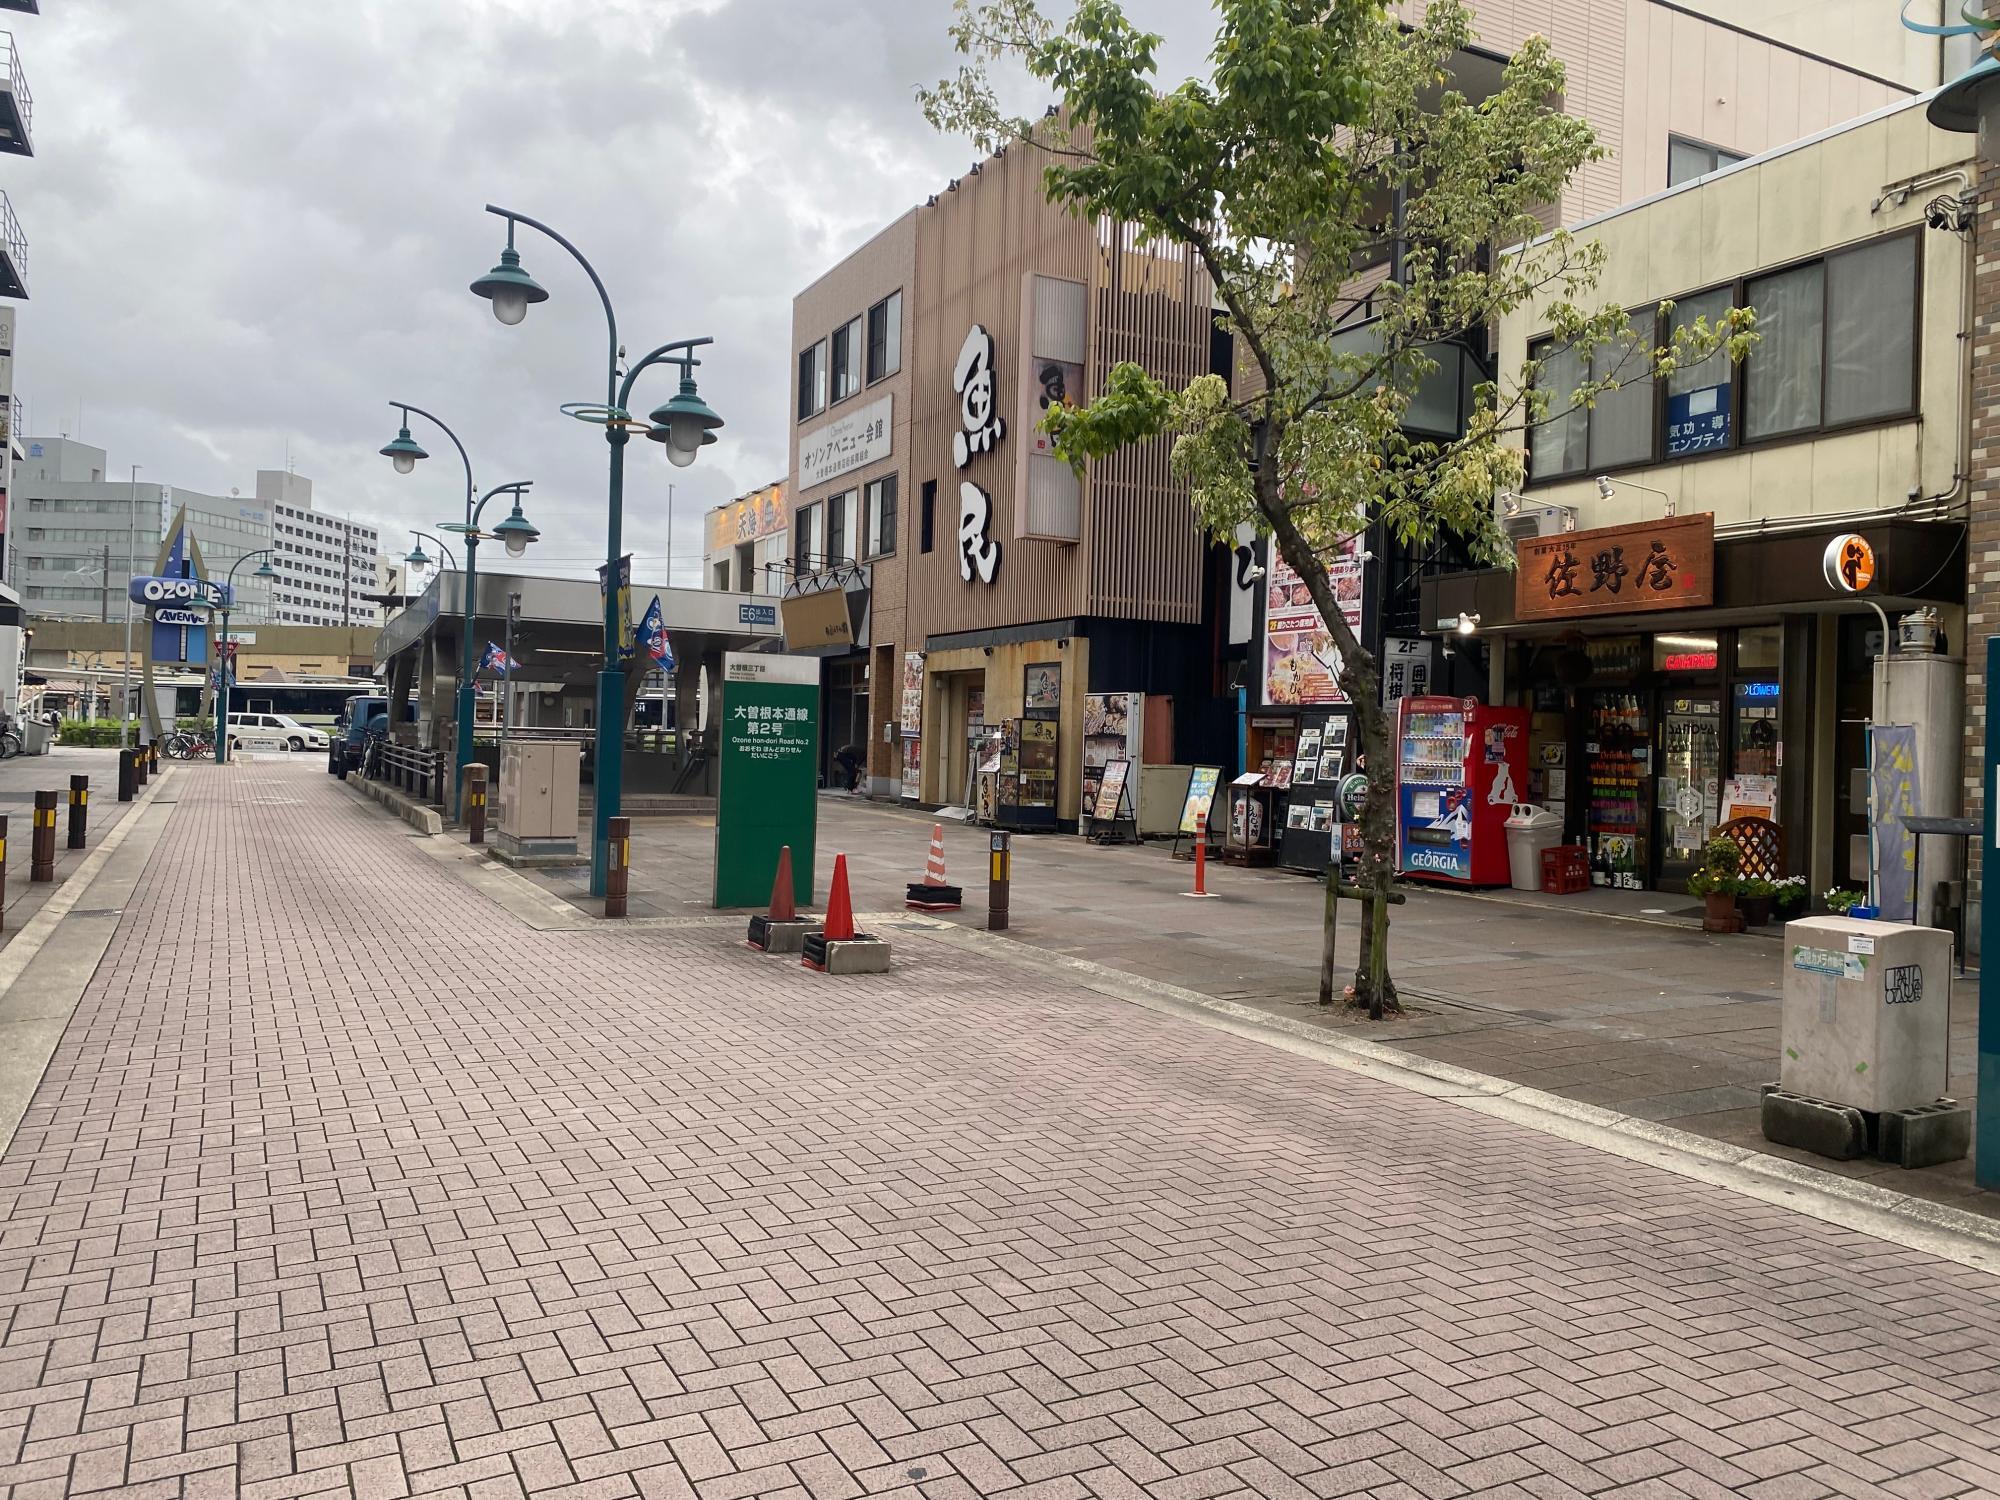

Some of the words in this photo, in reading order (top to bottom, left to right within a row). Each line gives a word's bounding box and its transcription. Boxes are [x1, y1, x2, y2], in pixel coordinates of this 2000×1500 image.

[143, 580, 222, 604] OZONE
[741, 607, 755, 621] E6
[1398, 640, 1418, 653] 2F
[1666, 652, 1716, 670] CAMPAR
[1389, 663, 1404, 701] 将棋
[734, 706, 808, 722] 大曽根本通線
[747, 722, 783, 736] 第2号
[1346, 792, 1367, 803] Hein
[1411, 849, 1459, 871] GEORGIA
